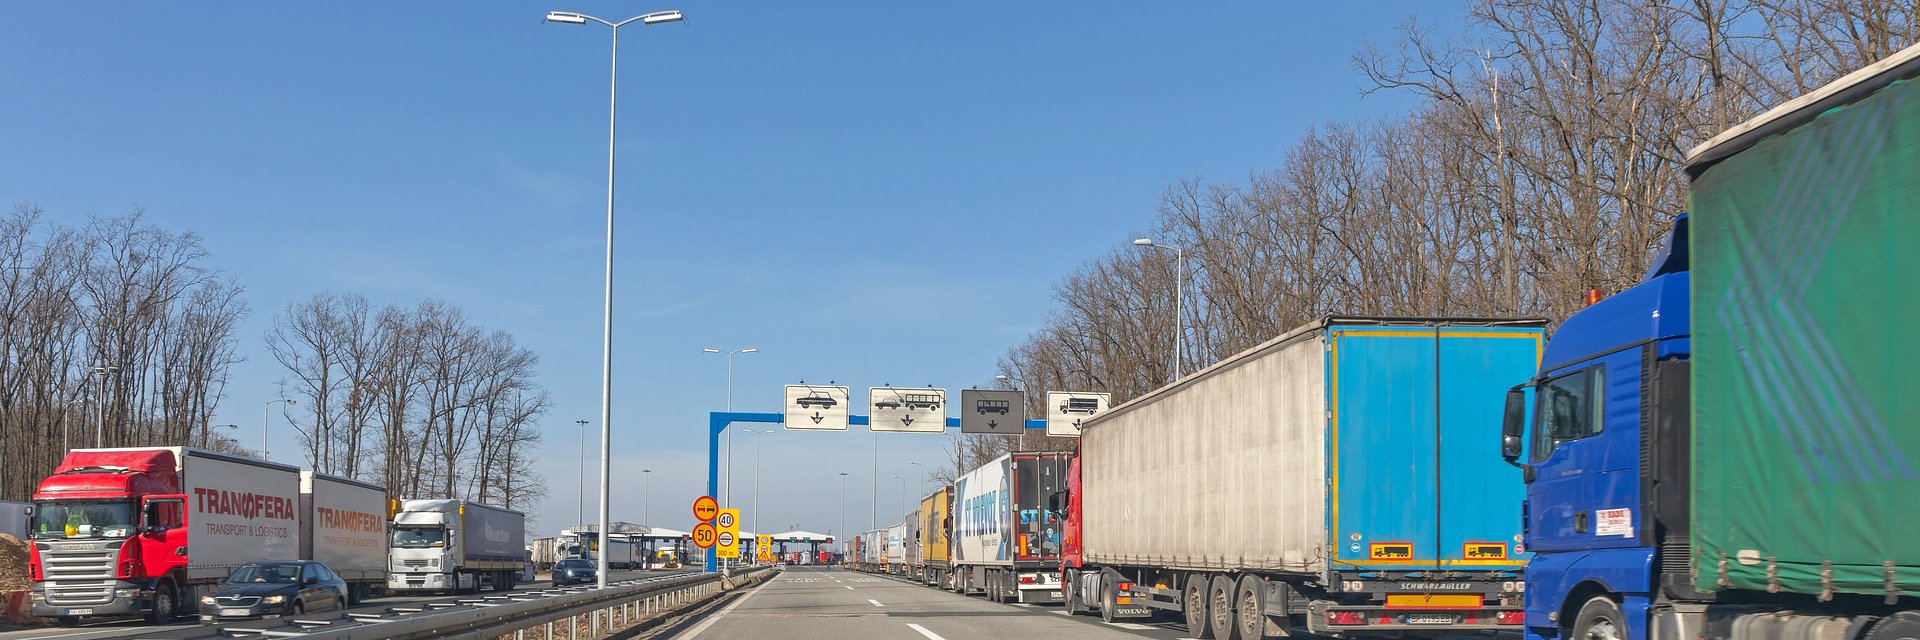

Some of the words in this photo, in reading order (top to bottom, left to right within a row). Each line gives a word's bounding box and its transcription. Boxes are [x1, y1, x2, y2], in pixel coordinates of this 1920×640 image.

[194, 487, 295, 521] TRANSFERA
[317, 507, 383, 533] TRANSFERA
[721, 516, 731, 525] 40
[1020, 509, 1038, 524] ST
[206, 523, 247, 537] TRANSPORT
[249, 525, 254, 536] &
[255, 526, 288, 538] LOGISTICS
[698, 529, 712, 542] 50
[60, 543, 95, 551] SCANIA
[324, 535, 352, 547] TRANSPORT
